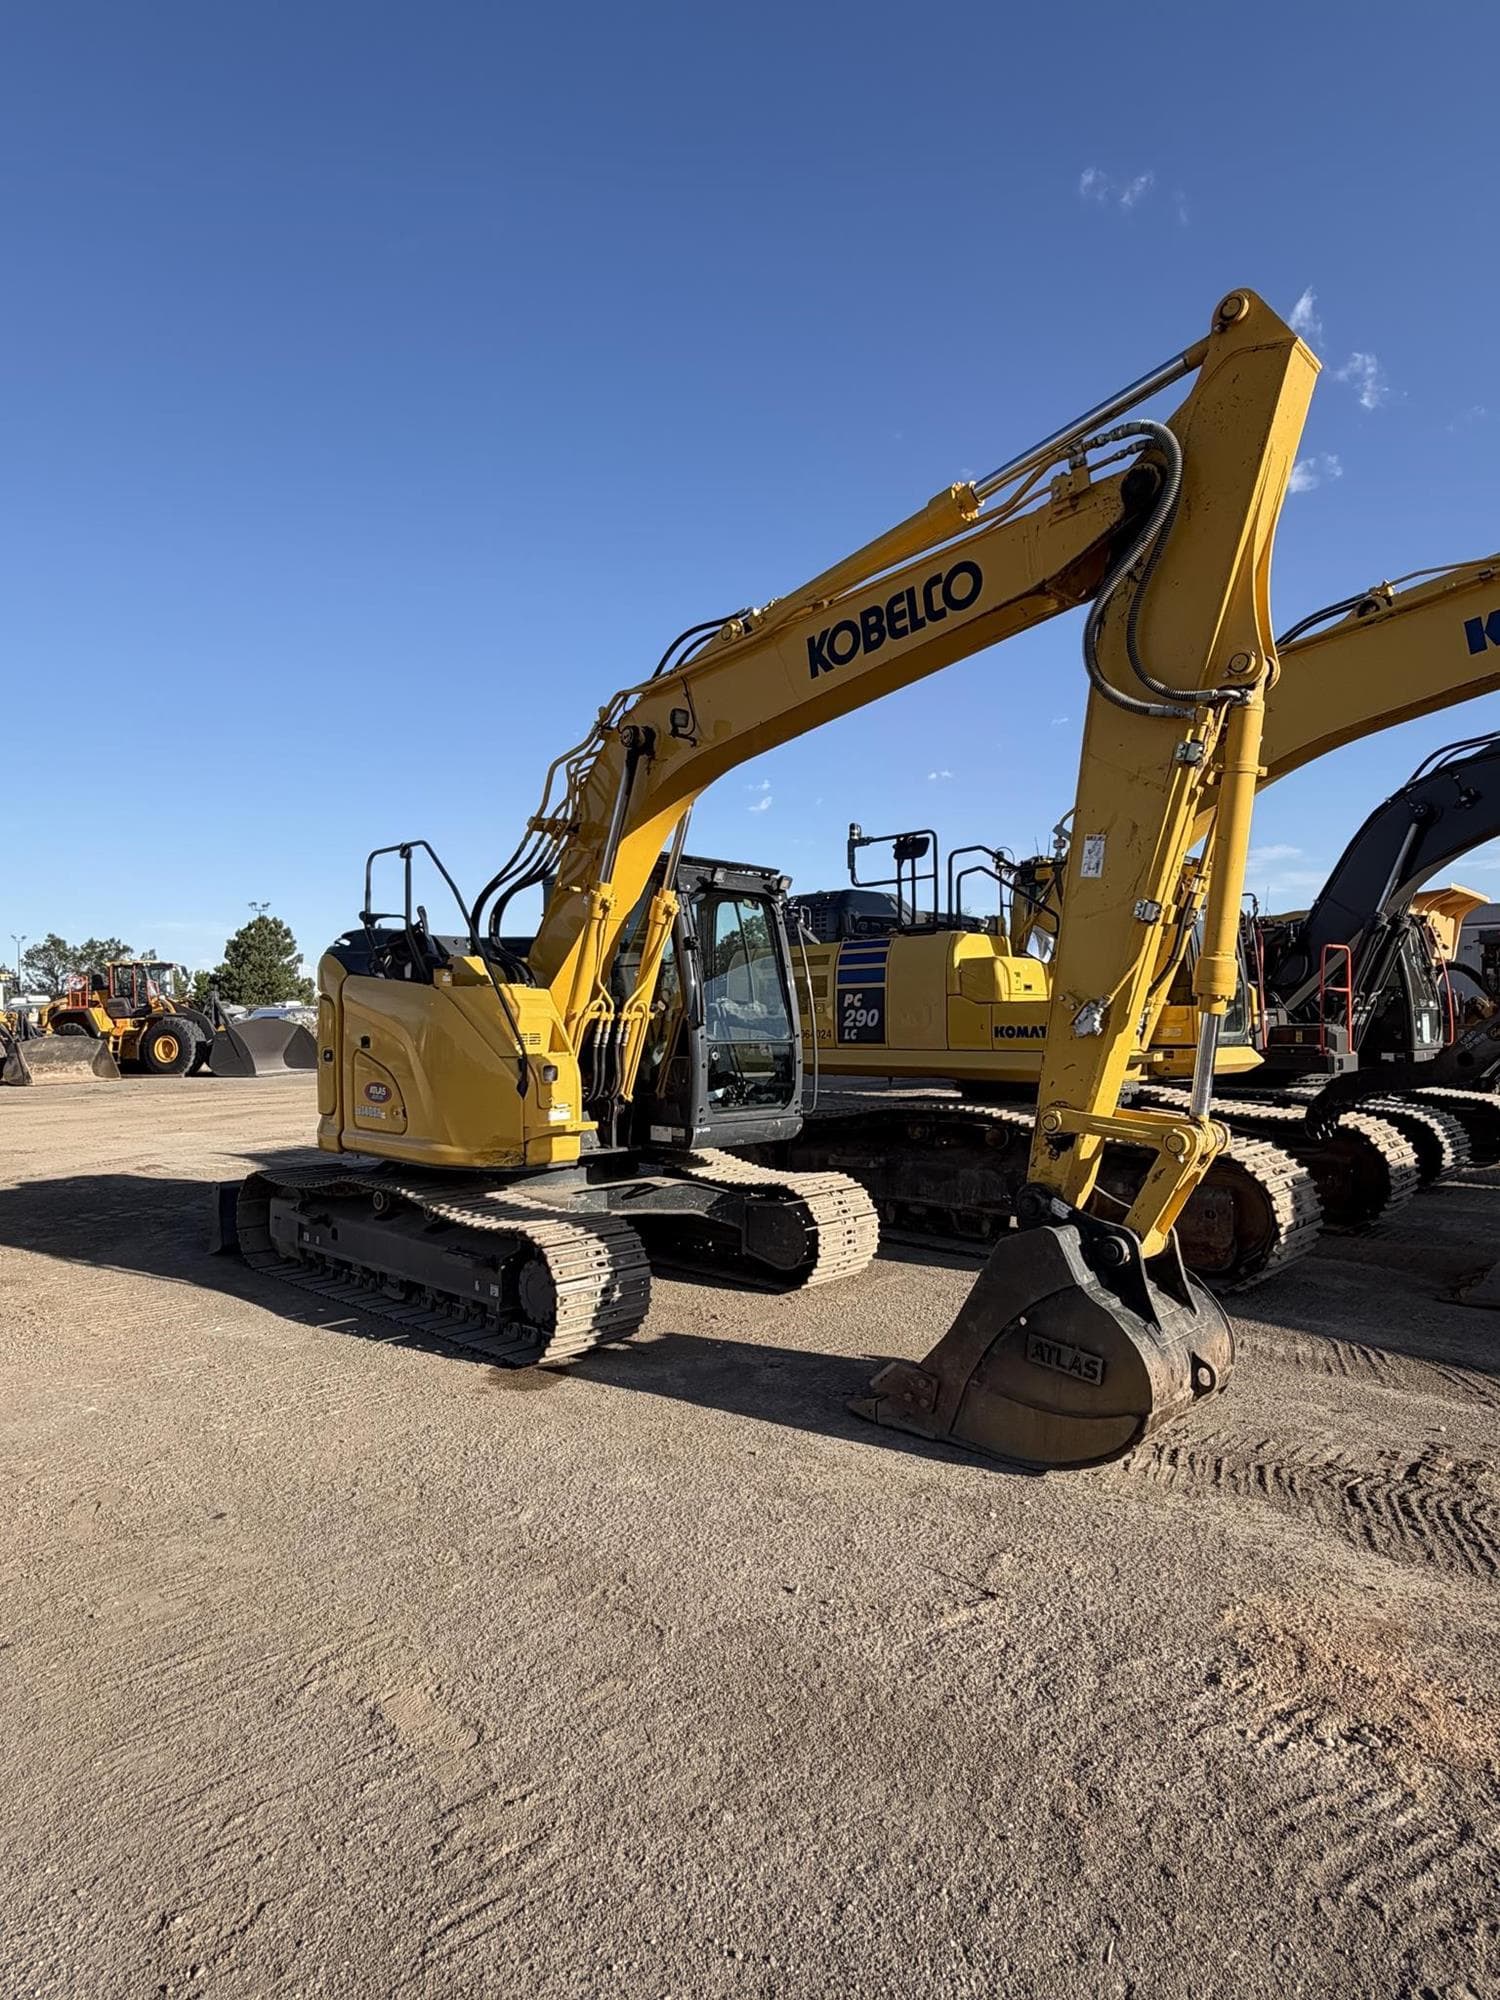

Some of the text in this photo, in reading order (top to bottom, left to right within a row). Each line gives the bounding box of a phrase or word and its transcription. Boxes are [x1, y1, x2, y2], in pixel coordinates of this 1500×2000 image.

[807, 560, 984, 679] KOBELCO
[843, 993, 863, 1007] PC
[842, 1009, 880, 1027] 290
[843, 1029, 858, 1040] LC
[1030, 1341, 1099, 1381] ATLAS
